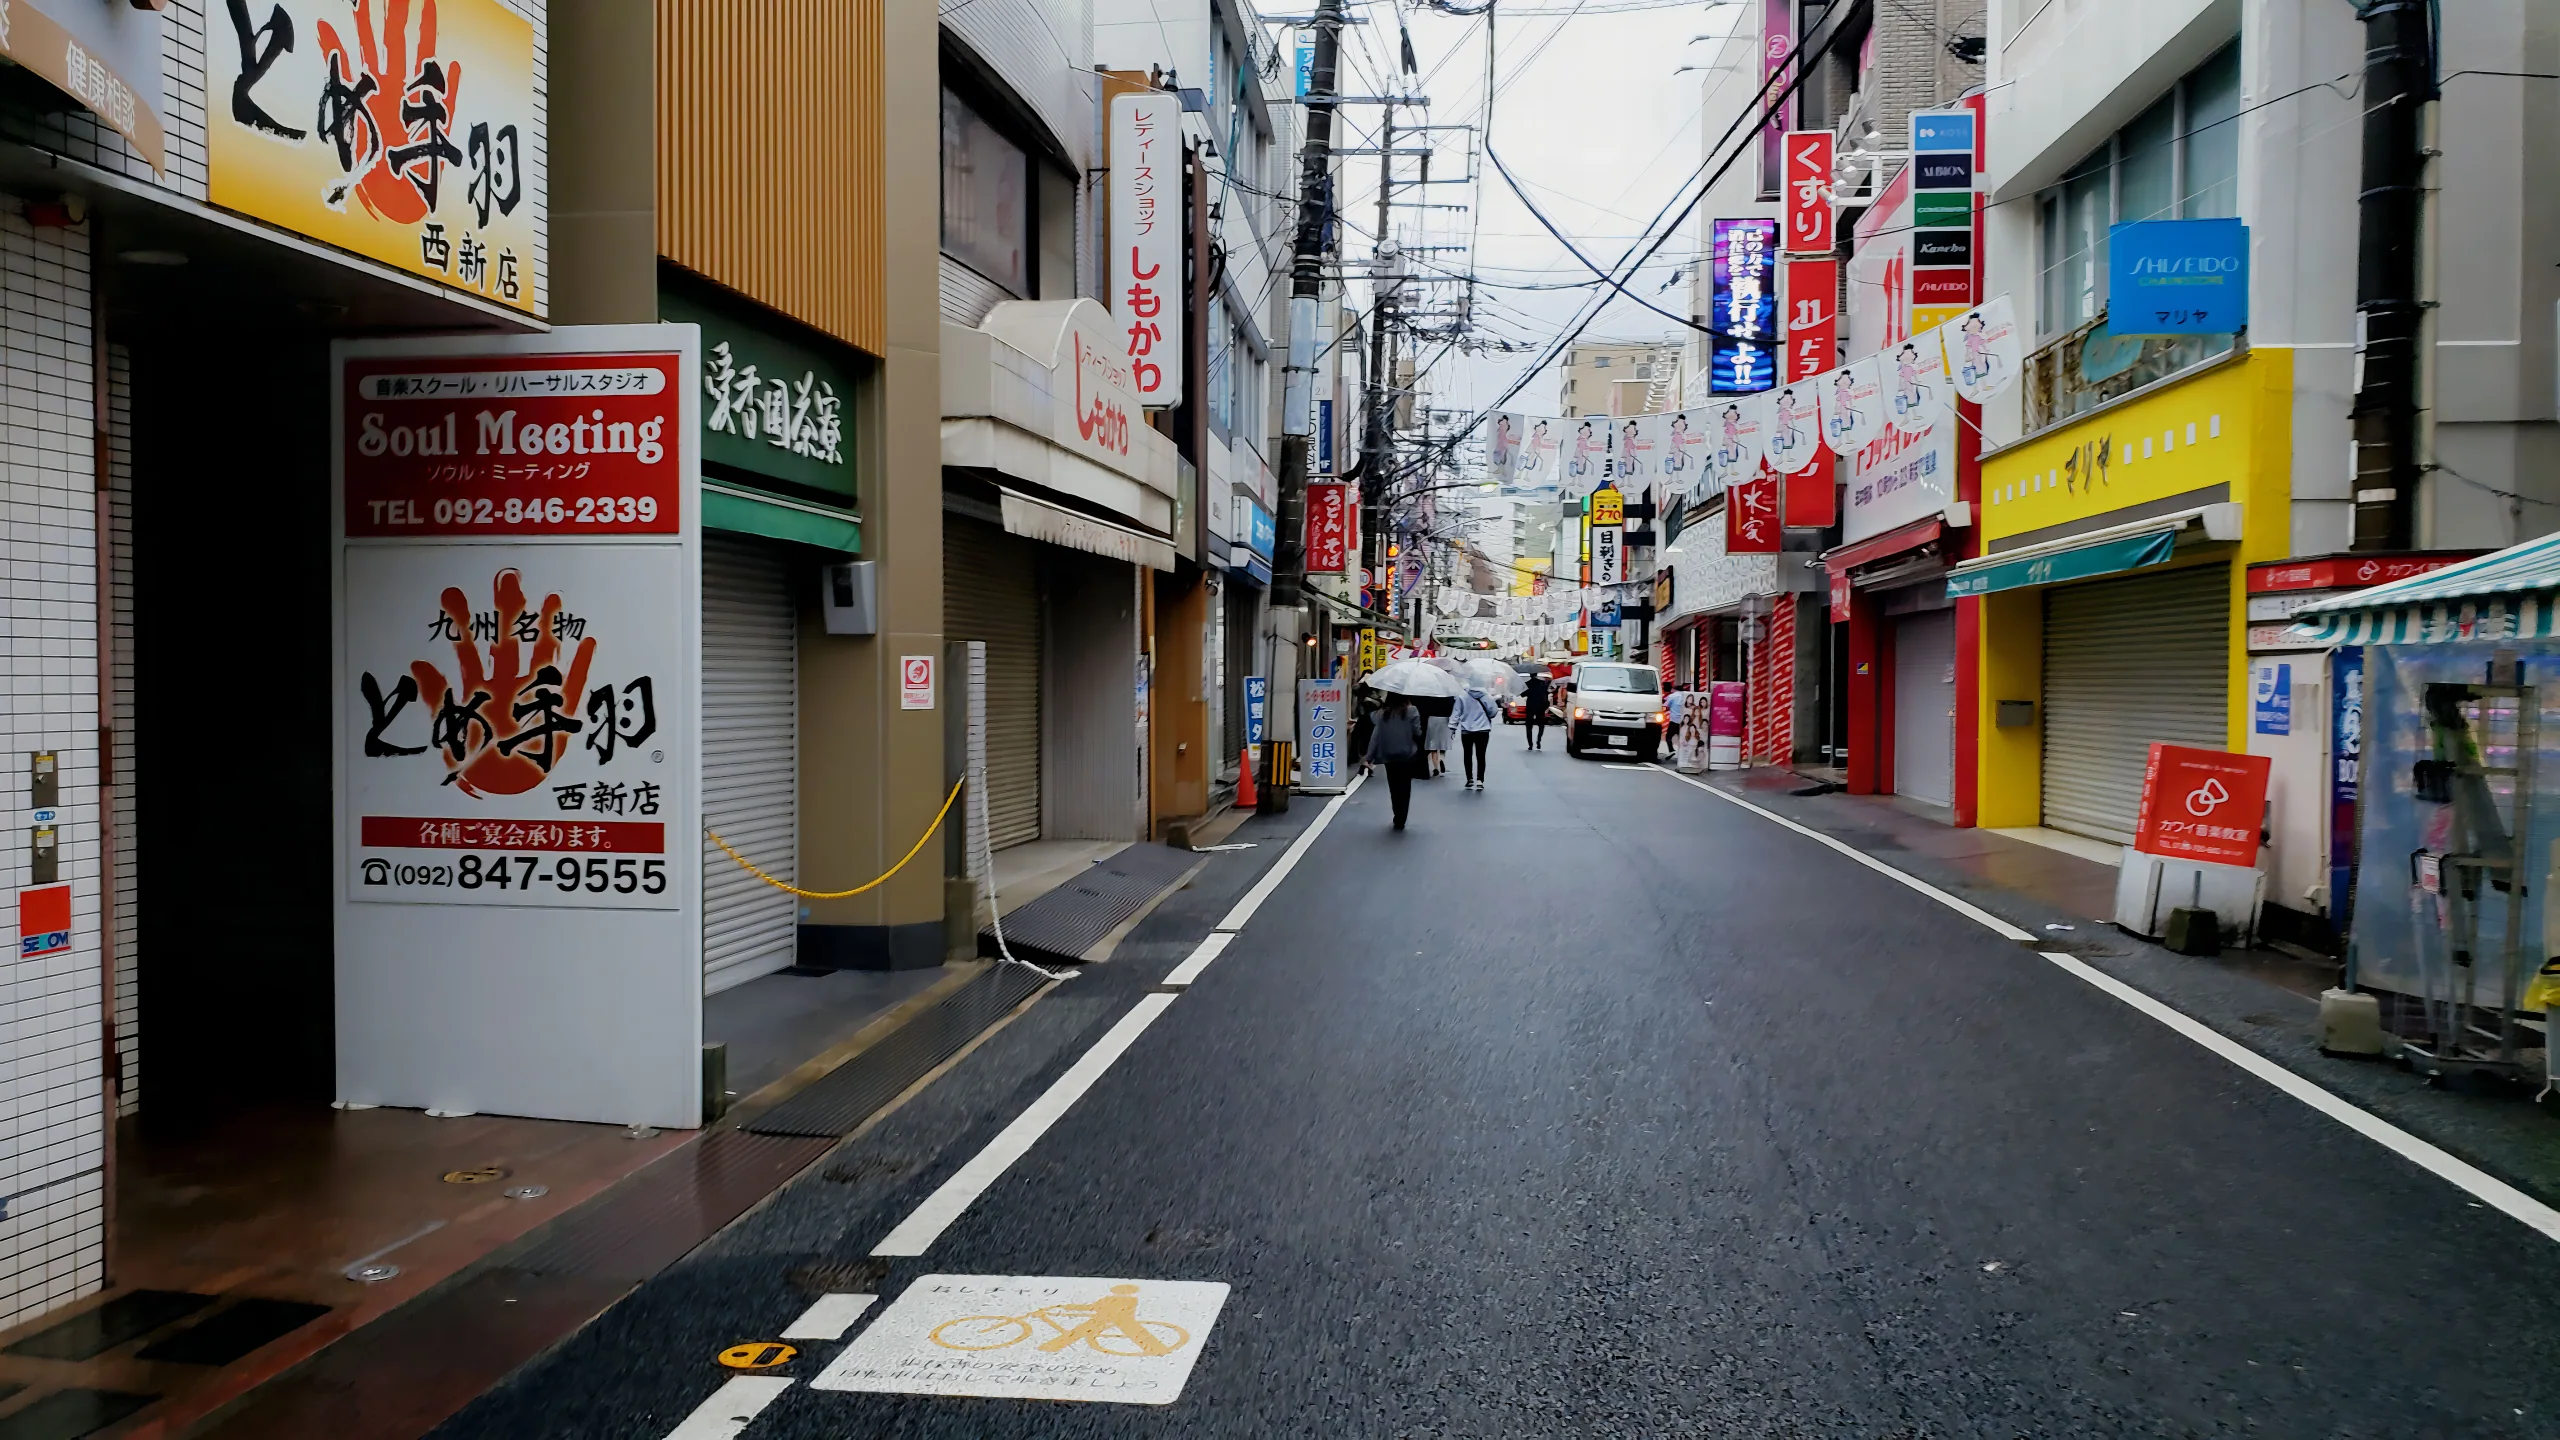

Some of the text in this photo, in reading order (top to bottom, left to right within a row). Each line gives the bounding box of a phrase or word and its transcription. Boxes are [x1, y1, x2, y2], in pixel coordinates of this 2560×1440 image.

[65, 40, 136, 140] 健康相談
[226, 0, 521, 229] とめ手羽
[1793, 141, 1832, 241] くすり
[421, 223, 520, 300] 西新店
[1127, 108, 1161, 393] レディースショップ しもかわ
[2129, 256, 2240, 275] SHISEIDO
[1918, 282, 1969, 292] SHISEIDO
[2155, 309, 2208, 325] マリヤ
[1799, 337, 1824, 379] ドラ
[376, 373, 649, 397] 音楽スクール・リハーサルスタジオ
[1074, 330, 1129, 456] しもかわ
[357, 409, 665, 464] Soul Meeting
[427, 461, 590, 481] ソウル・ミーティング
[367, 496, 658, 525] TEL 092-846-2339
[1322, 489, 1342, 567] うどん そば
[428, 609, 587, 645] 九州名物
[360, 665, 657, 786] とめ手羽
[1312, 705, 1336, 779] たの眼科
[552, 780, 661, 817] 西新店
[418, 820, 612, 850] 各種ご宴会承ります。
[23, 931, 69, 953] SEOM
